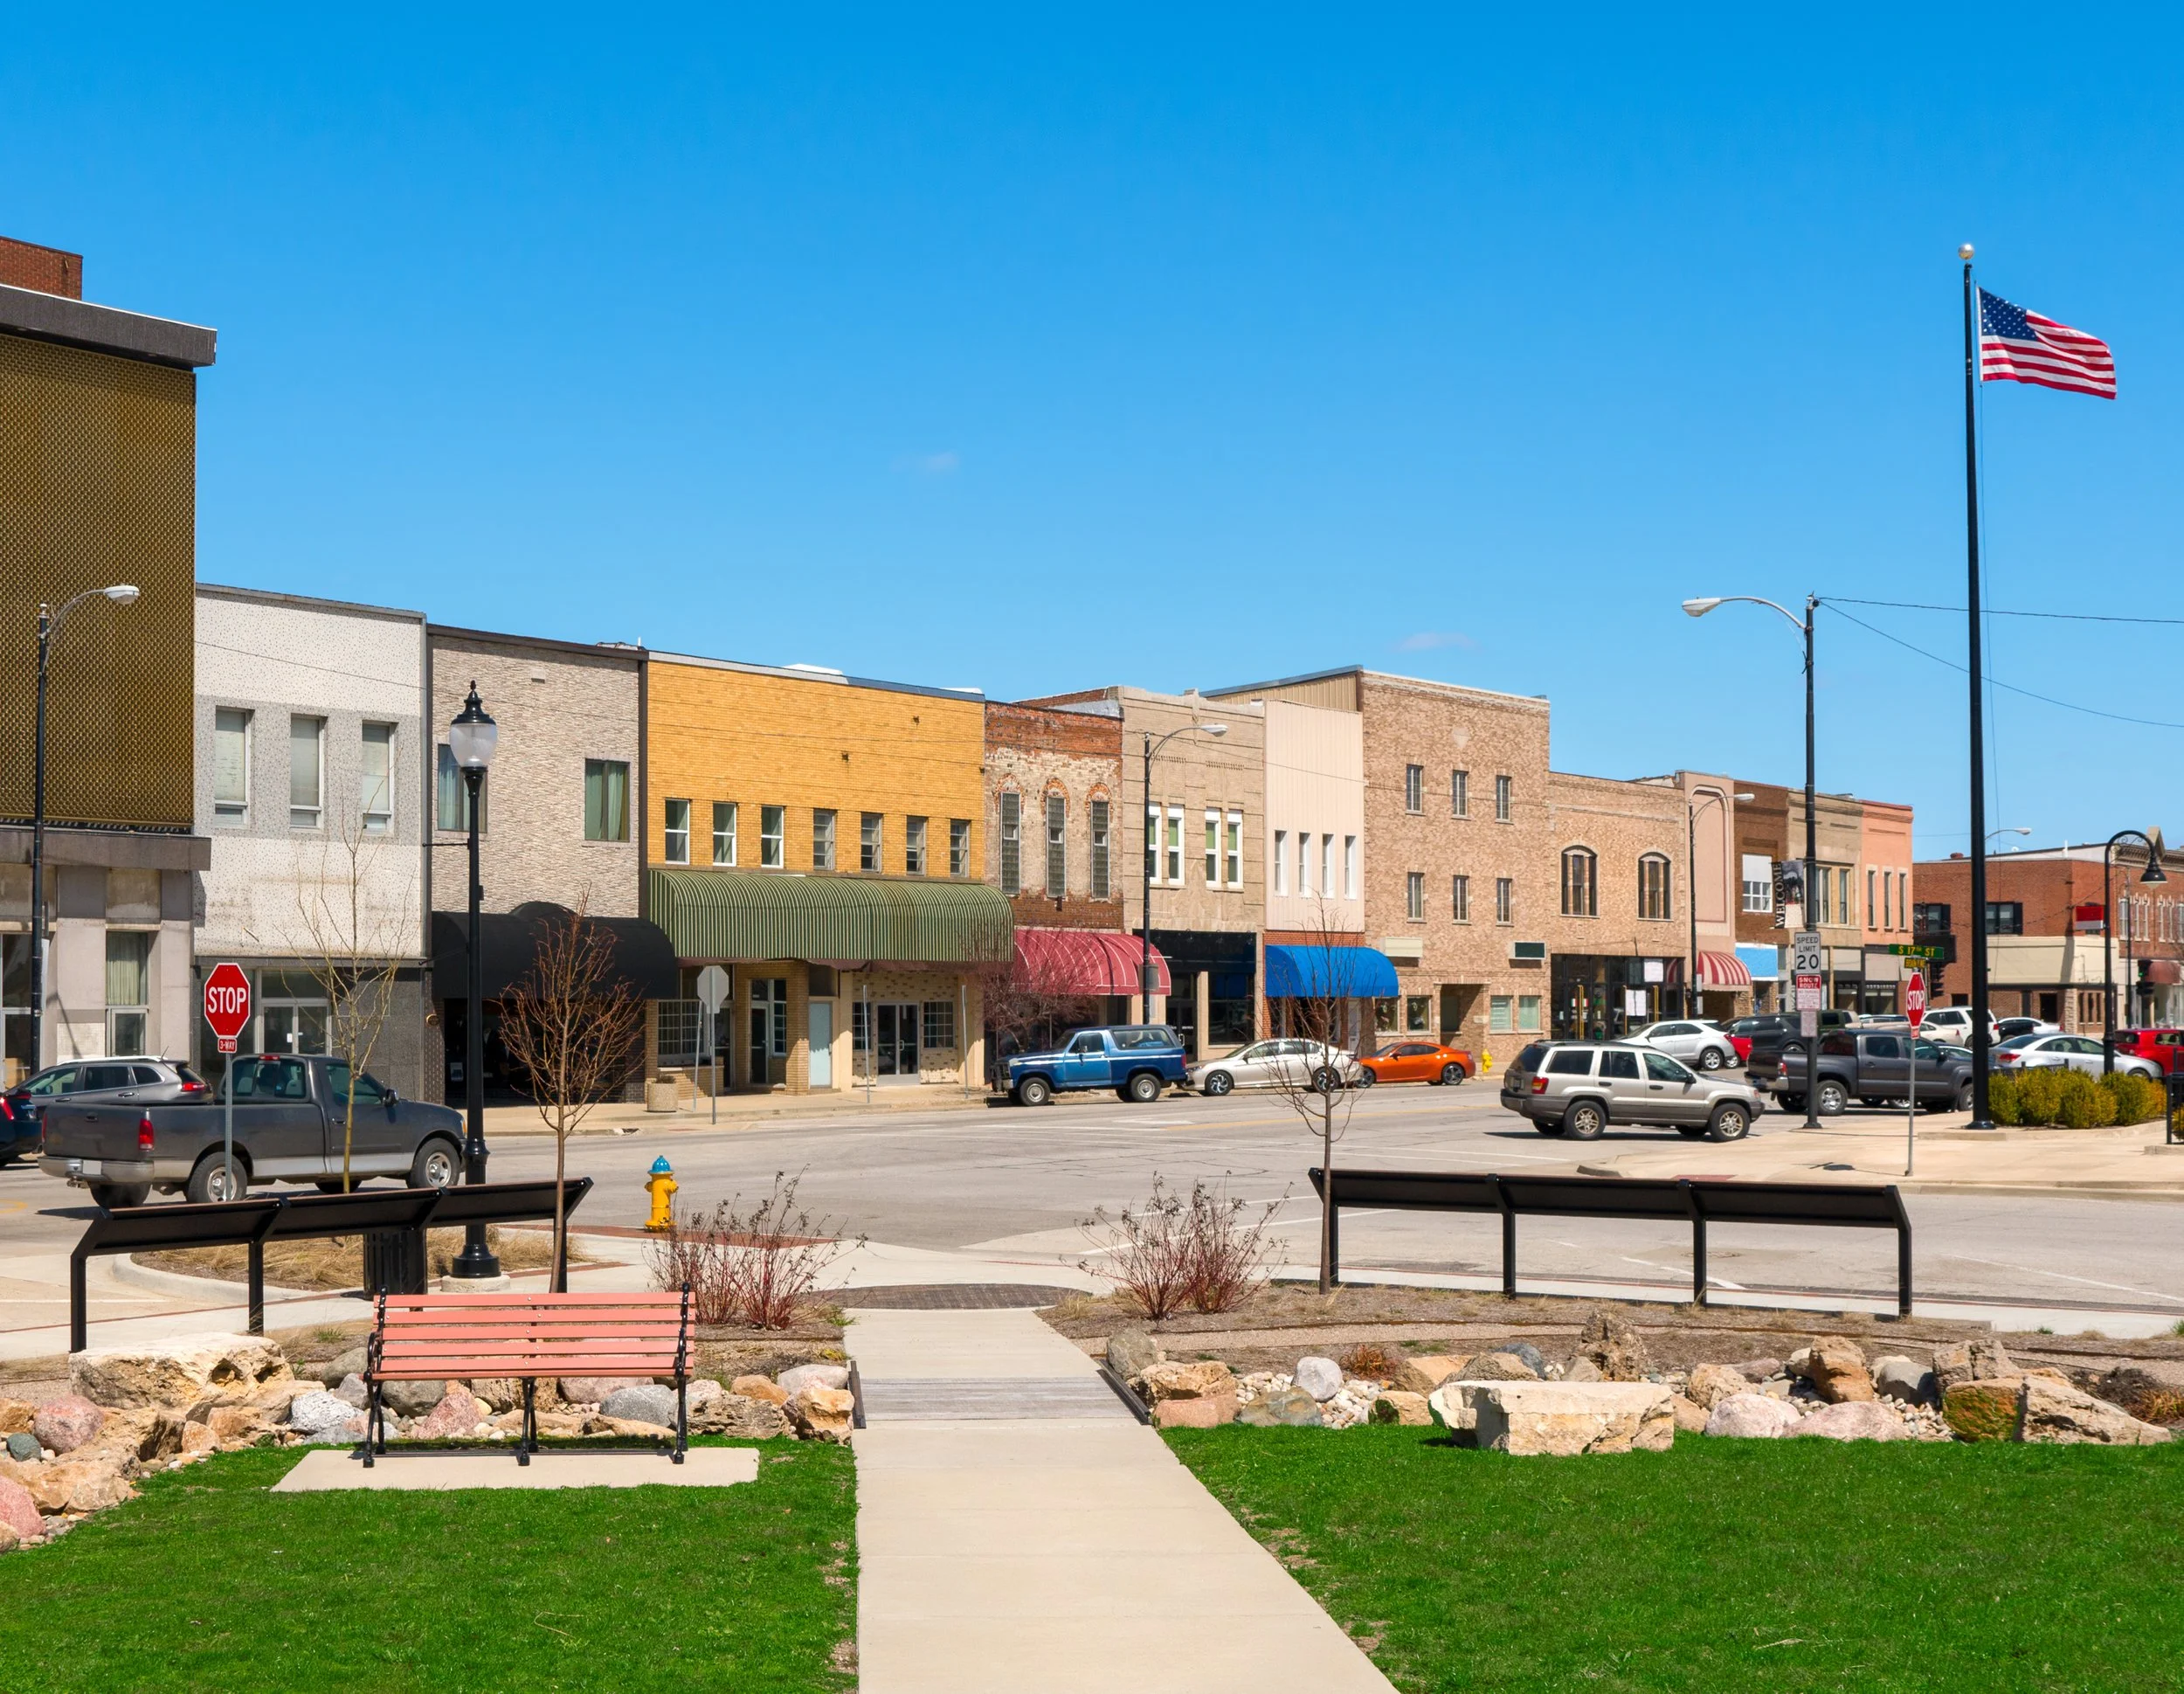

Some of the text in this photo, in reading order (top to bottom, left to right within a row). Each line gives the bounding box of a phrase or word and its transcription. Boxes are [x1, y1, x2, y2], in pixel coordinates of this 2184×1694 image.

[1773, 862, 1786, 927] WELCOME
[1898, 945, 1904, 954] S
[1925, 948, 1935, 957] ST
[1797, 954, 1819, 970] 20
[208, 986, 246, 1013] STOP
[1908, 991, 1925, 1010] STOP
[220, 1041, 235, 1049] 3-WAY
